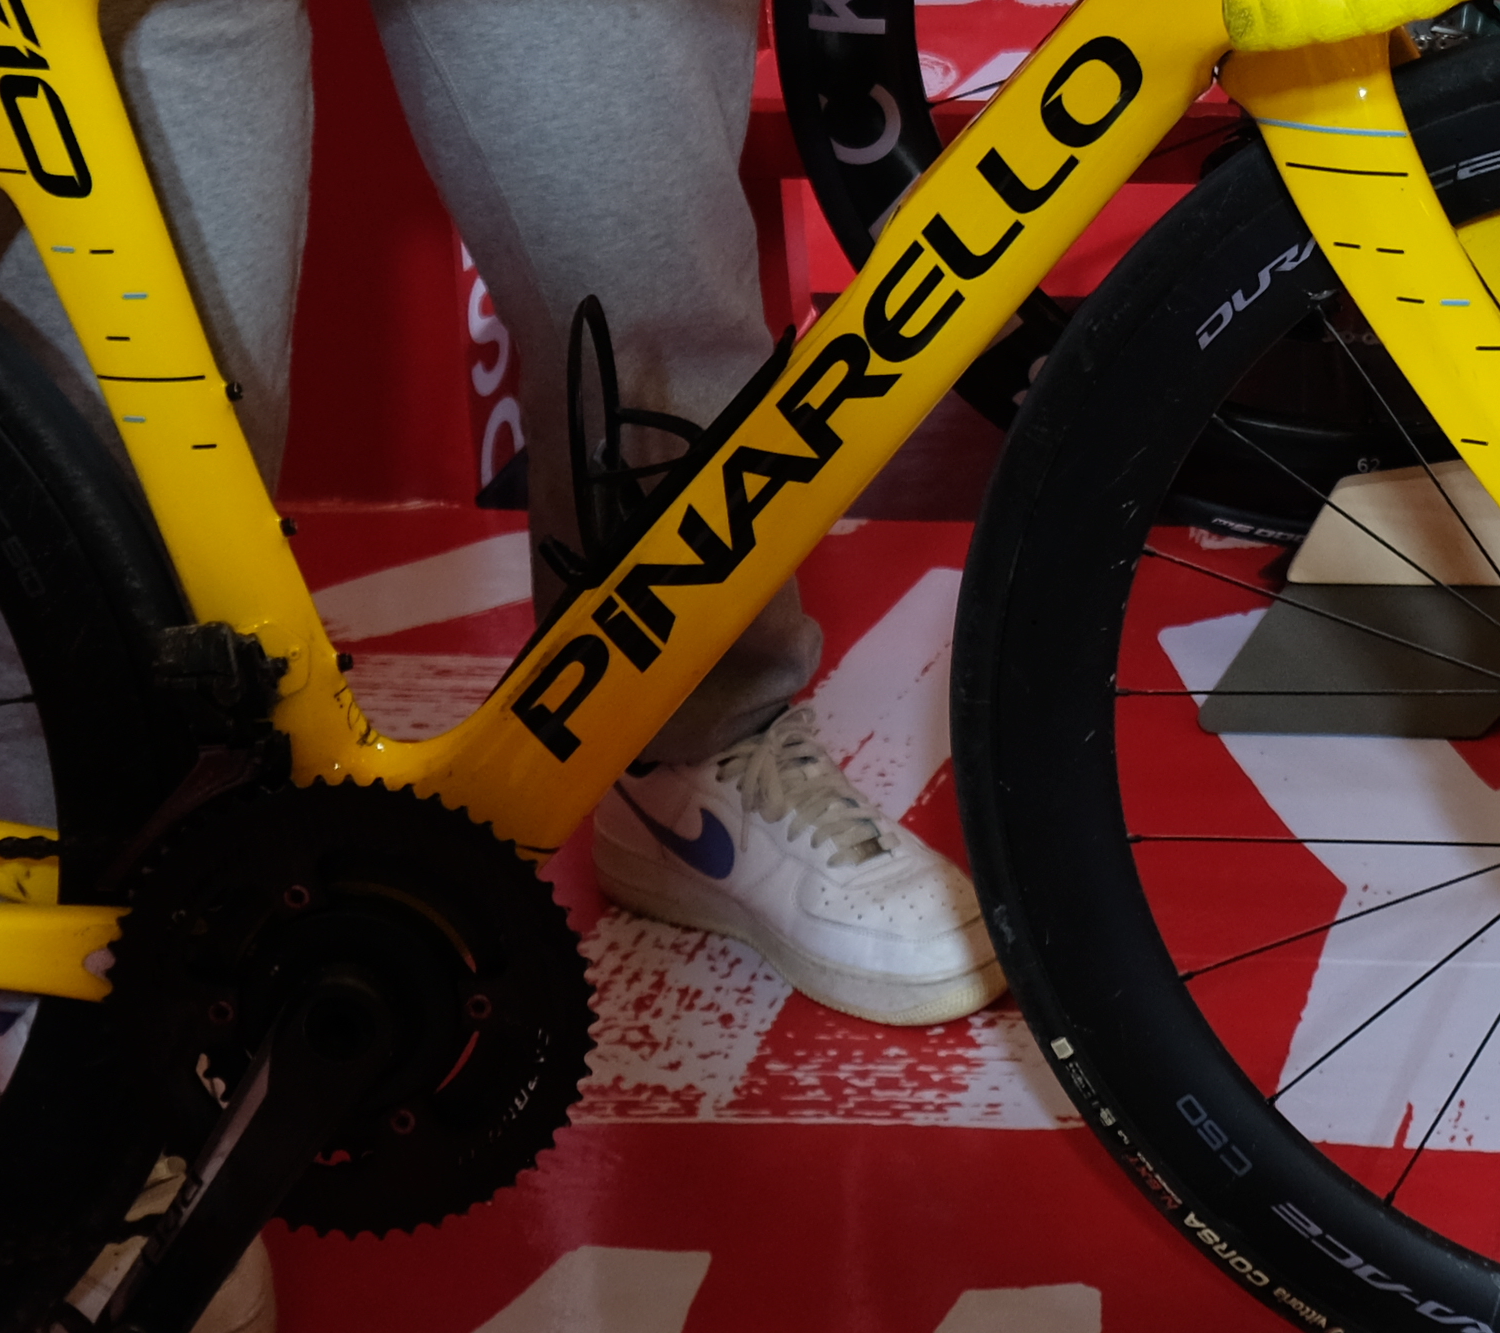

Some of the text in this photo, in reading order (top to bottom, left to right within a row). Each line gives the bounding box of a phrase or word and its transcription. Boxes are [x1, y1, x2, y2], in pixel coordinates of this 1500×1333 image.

[511, 34, 1144, 763] PINARELLO
[1175, 1092, 1254, 1178] C50
[1183, 1209, 1271, 1290] CORSA
